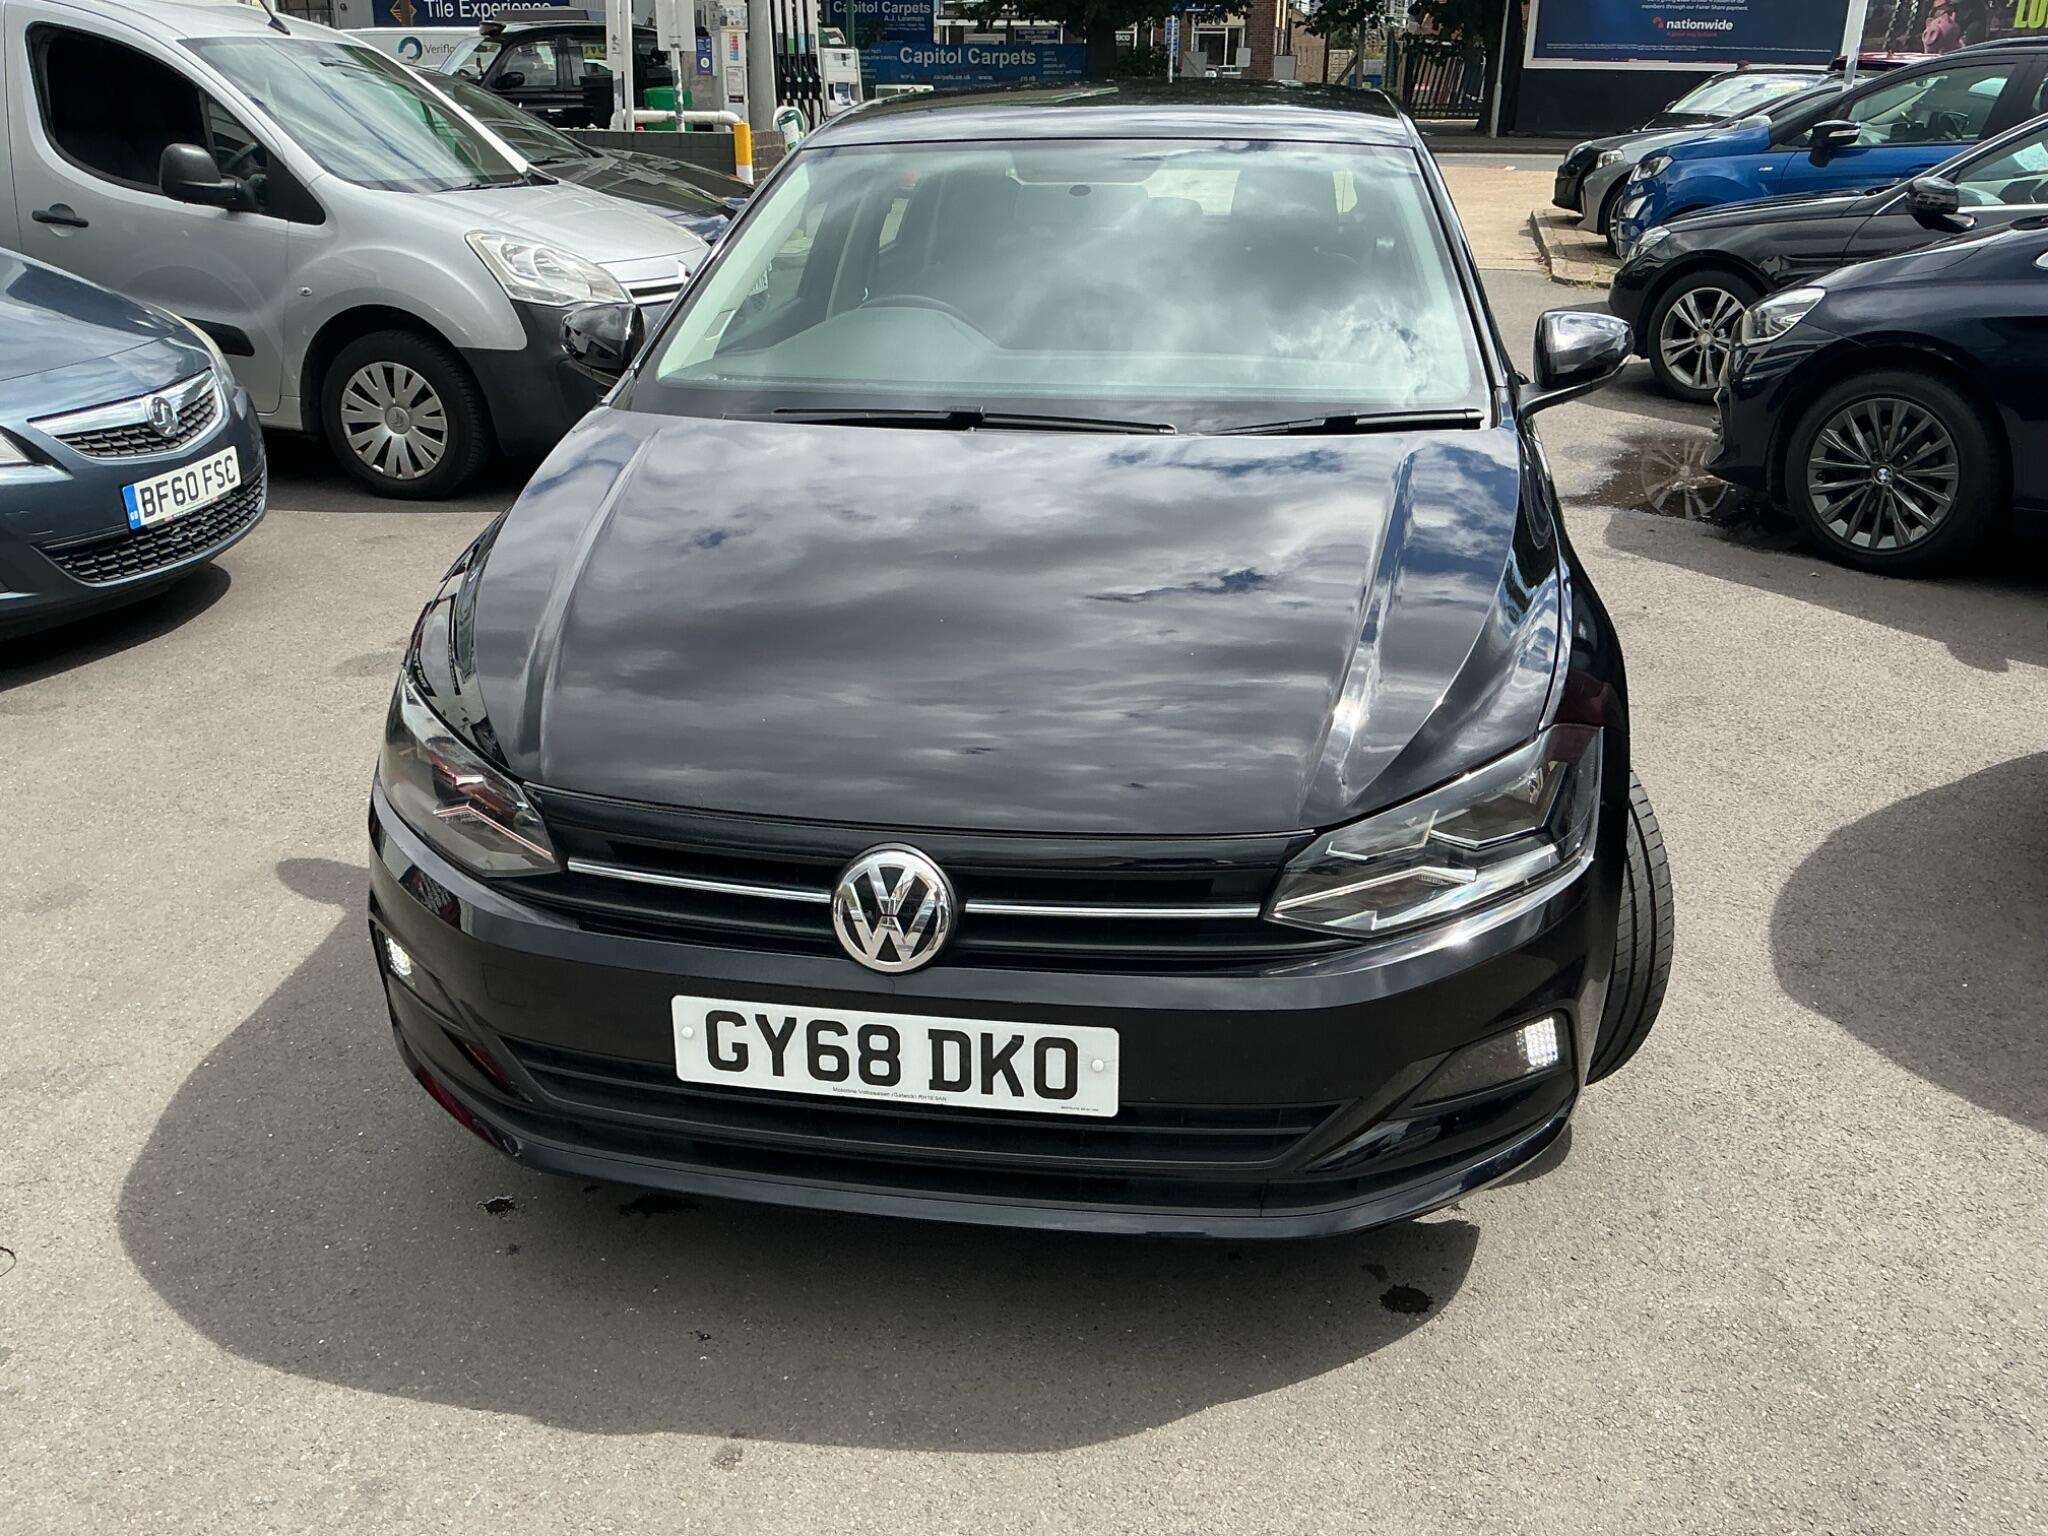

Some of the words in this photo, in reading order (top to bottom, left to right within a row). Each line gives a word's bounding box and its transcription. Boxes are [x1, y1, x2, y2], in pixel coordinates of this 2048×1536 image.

[423, 0, 454, 18] Tile
[881, 1, 931, 16] Carpets
[1666, 18, 1734, 31] nationwide
[900, 46, 962, 67] Capitol
[968, 48, 1036, 68] Carpets
[140, 471, 199, 518] BF60
[201, 454, 237, 496] FSC
[705, 1009, 902, 1088] GY68
[927, 1027, 1079, 1101] DKO
